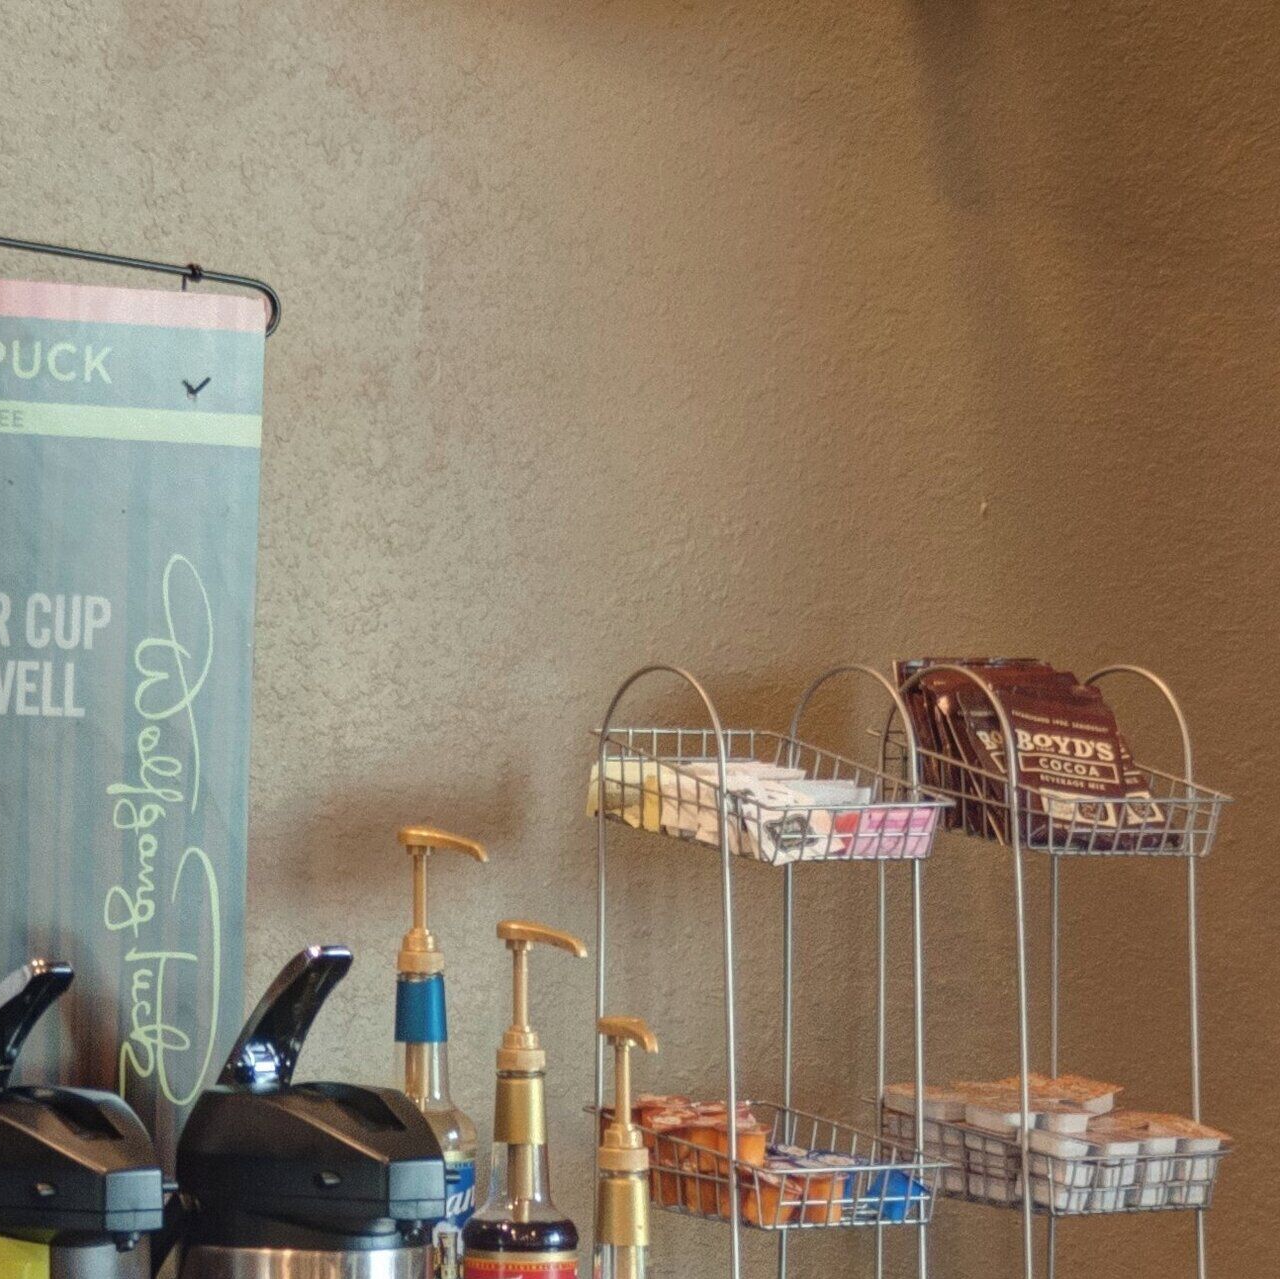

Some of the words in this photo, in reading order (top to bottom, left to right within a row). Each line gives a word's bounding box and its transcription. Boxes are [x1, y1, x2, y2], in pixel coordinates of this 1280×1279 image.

[25, 592, 112, 650] CUP
[1015, 728, 1115, 762] BOYD'S
[1039, 757, 1101, 778] COCOA
